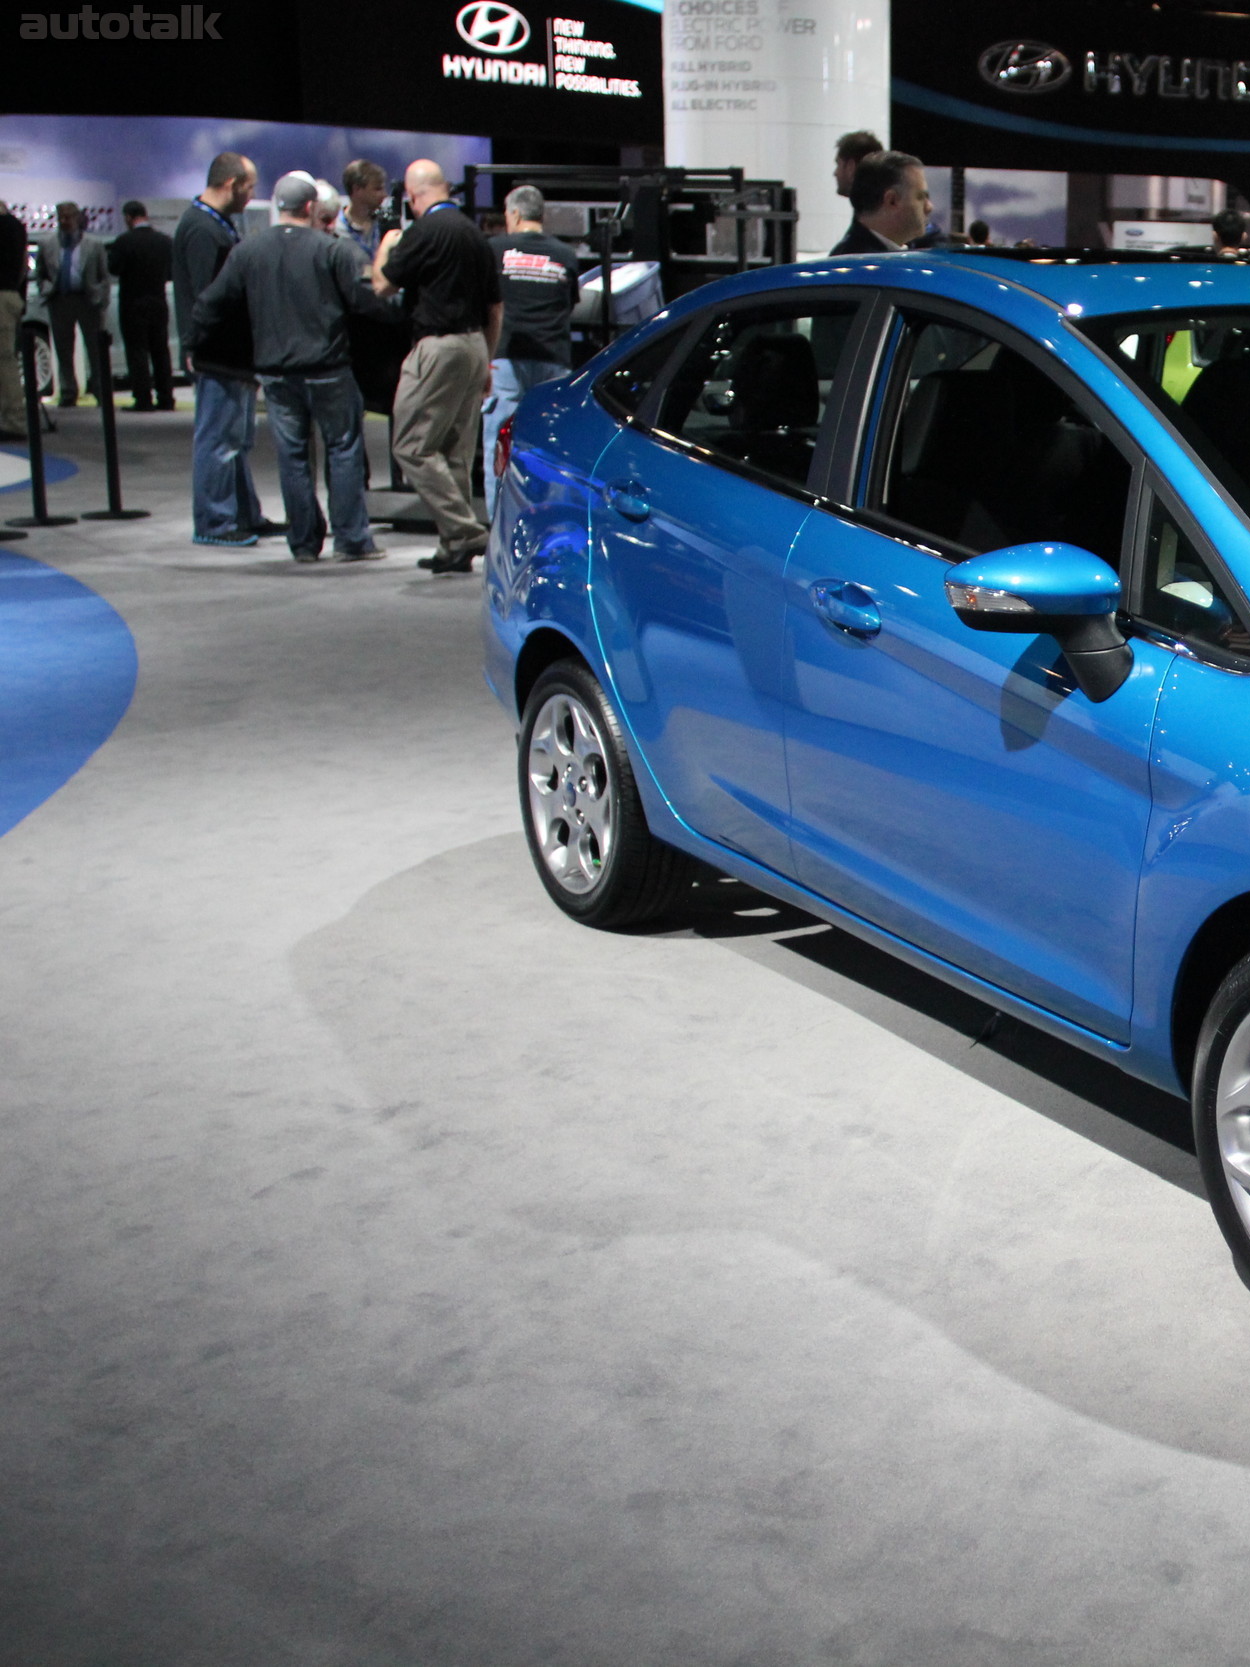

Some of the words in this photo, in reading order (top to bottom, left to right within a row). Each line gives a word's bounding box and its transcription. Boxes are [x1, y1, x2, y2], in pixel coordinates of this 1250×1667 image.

[553, 17, 585, 37] NEW
[747, 18, 816, 35] PWER
[715, 35, 763, 51] FORD
[442, 53, 547, 87] HYUNDAI
[554, 54, 586, 73] NEW
[699, 61, 752, 72] HYBRID
